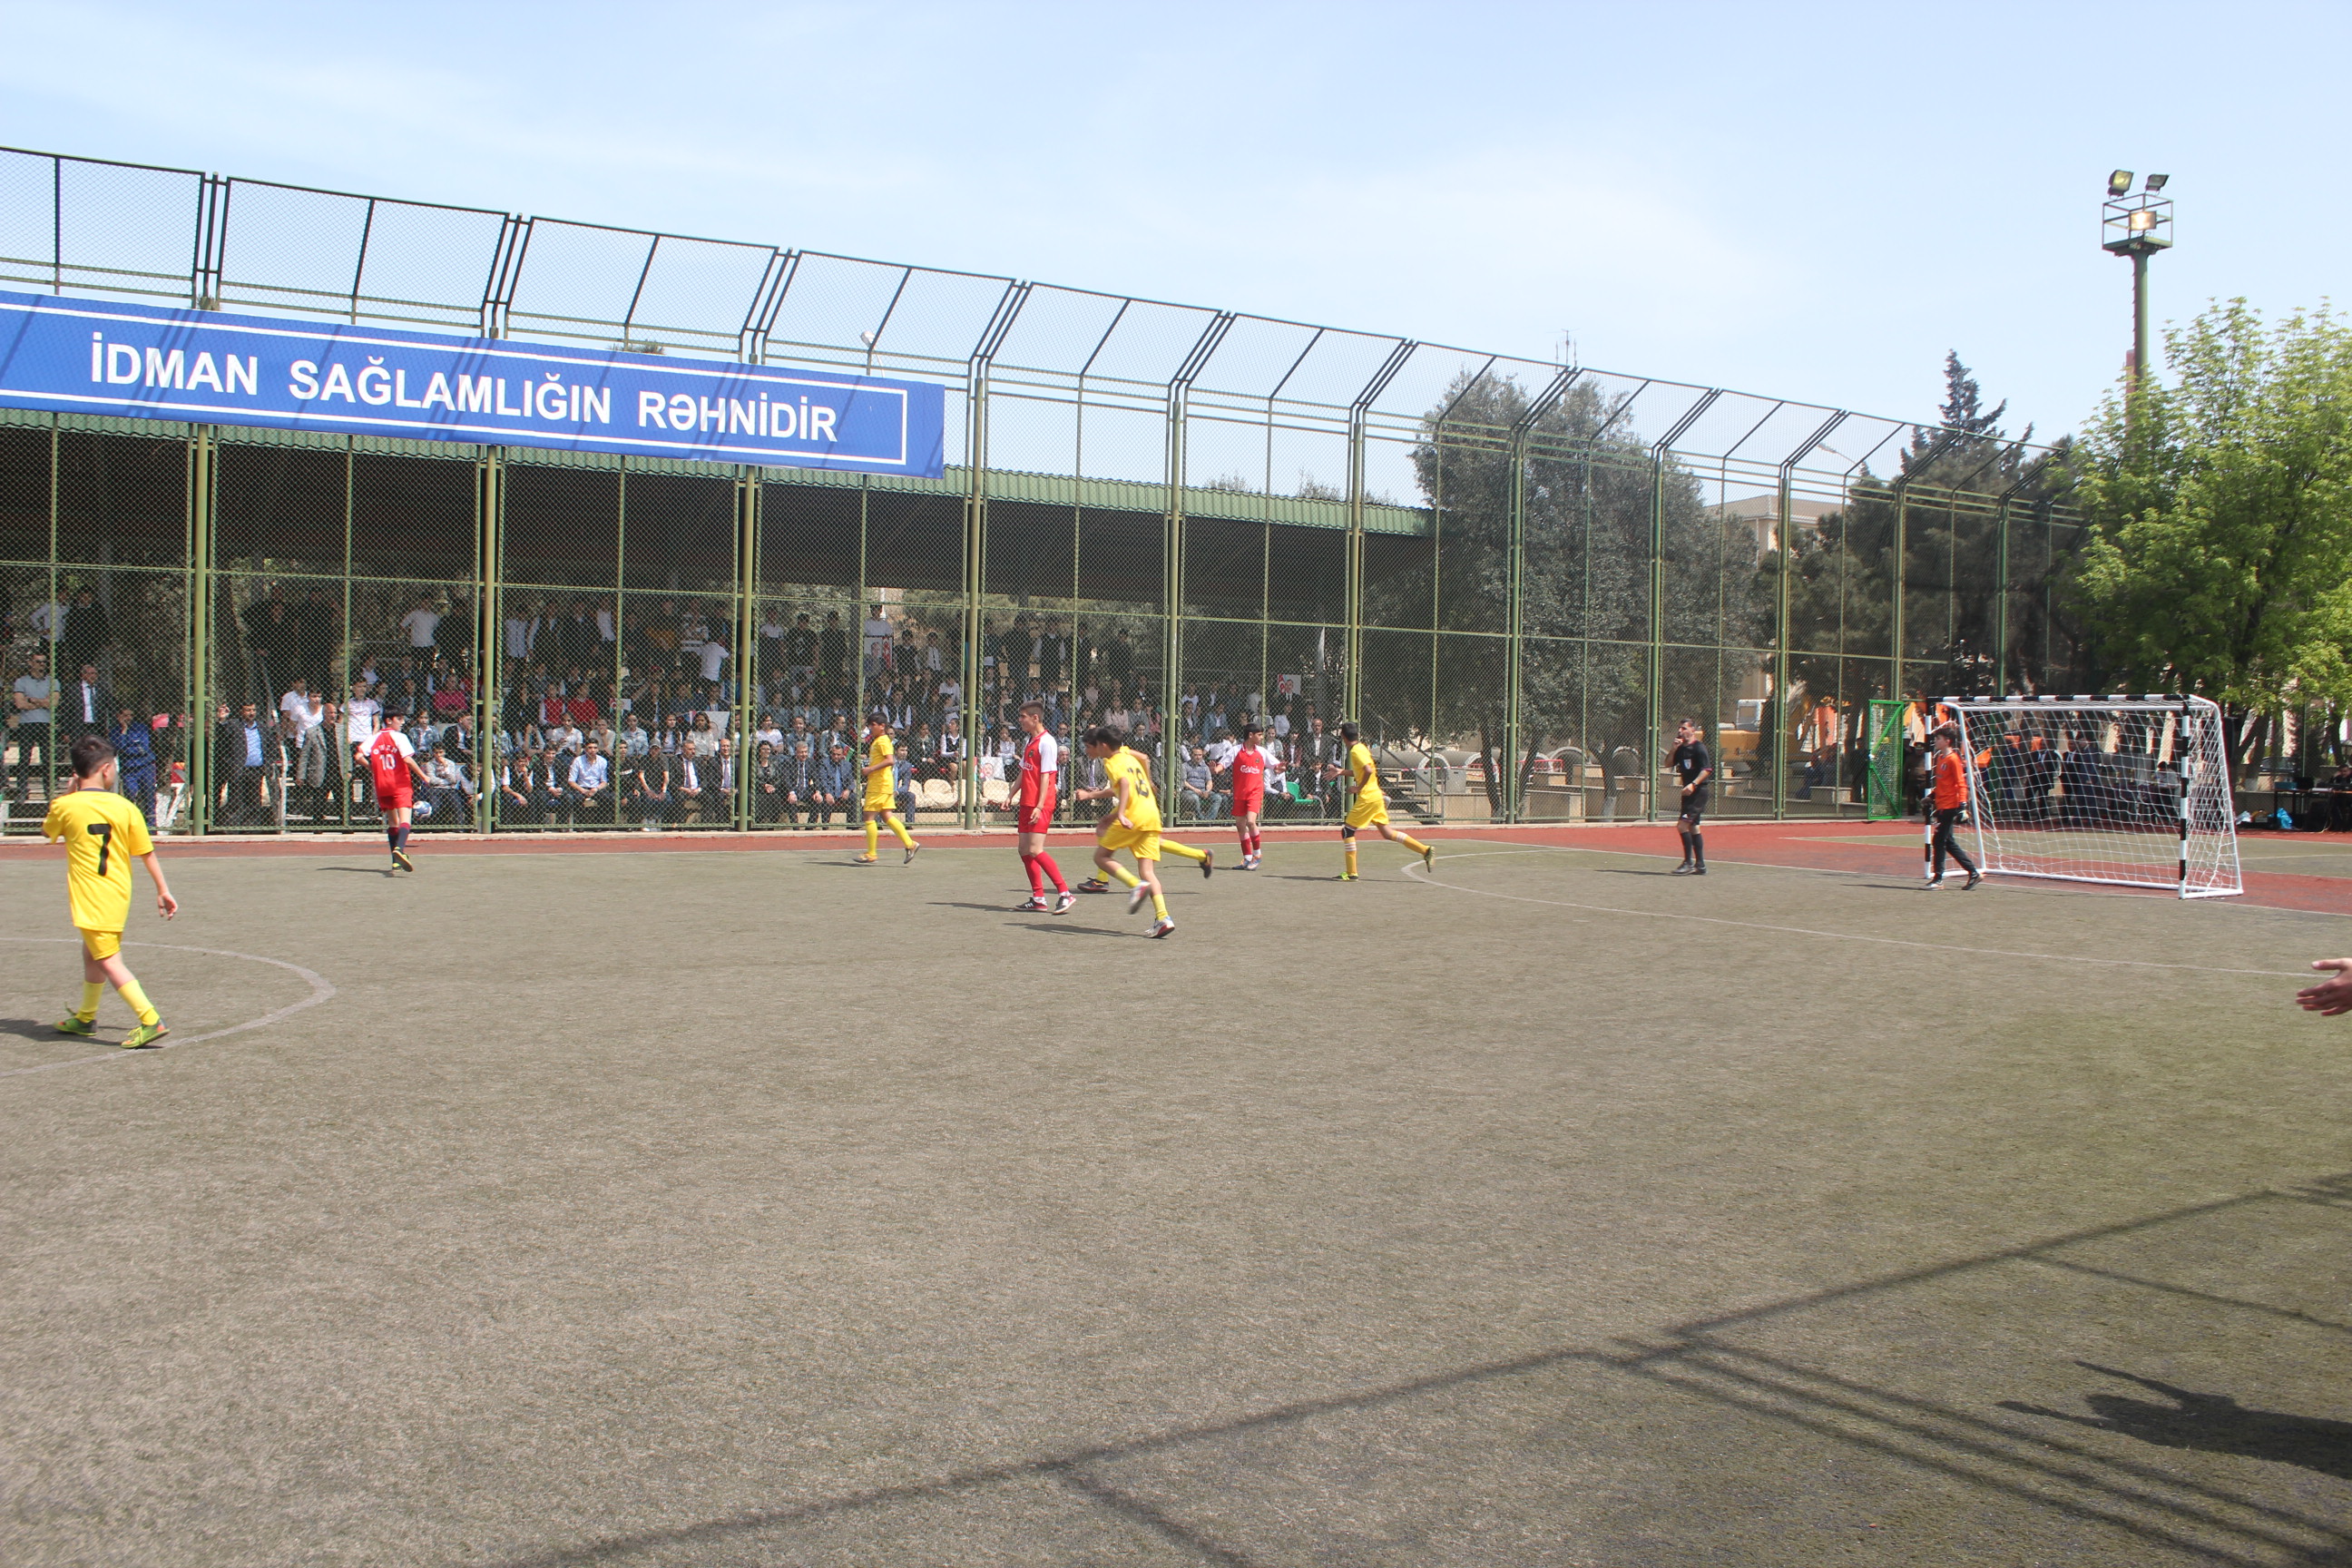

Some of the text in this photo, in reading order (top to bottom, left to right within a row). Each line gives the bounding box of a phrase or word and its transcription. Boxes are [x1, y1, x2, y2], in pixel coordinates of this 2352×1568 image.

[92, 331, 838, 442] İDMAN SAĞLAMLIĞIN RƏHNİDİR
[379, 753, 396, 770] 10
[87, 823, 112, 877] 7
